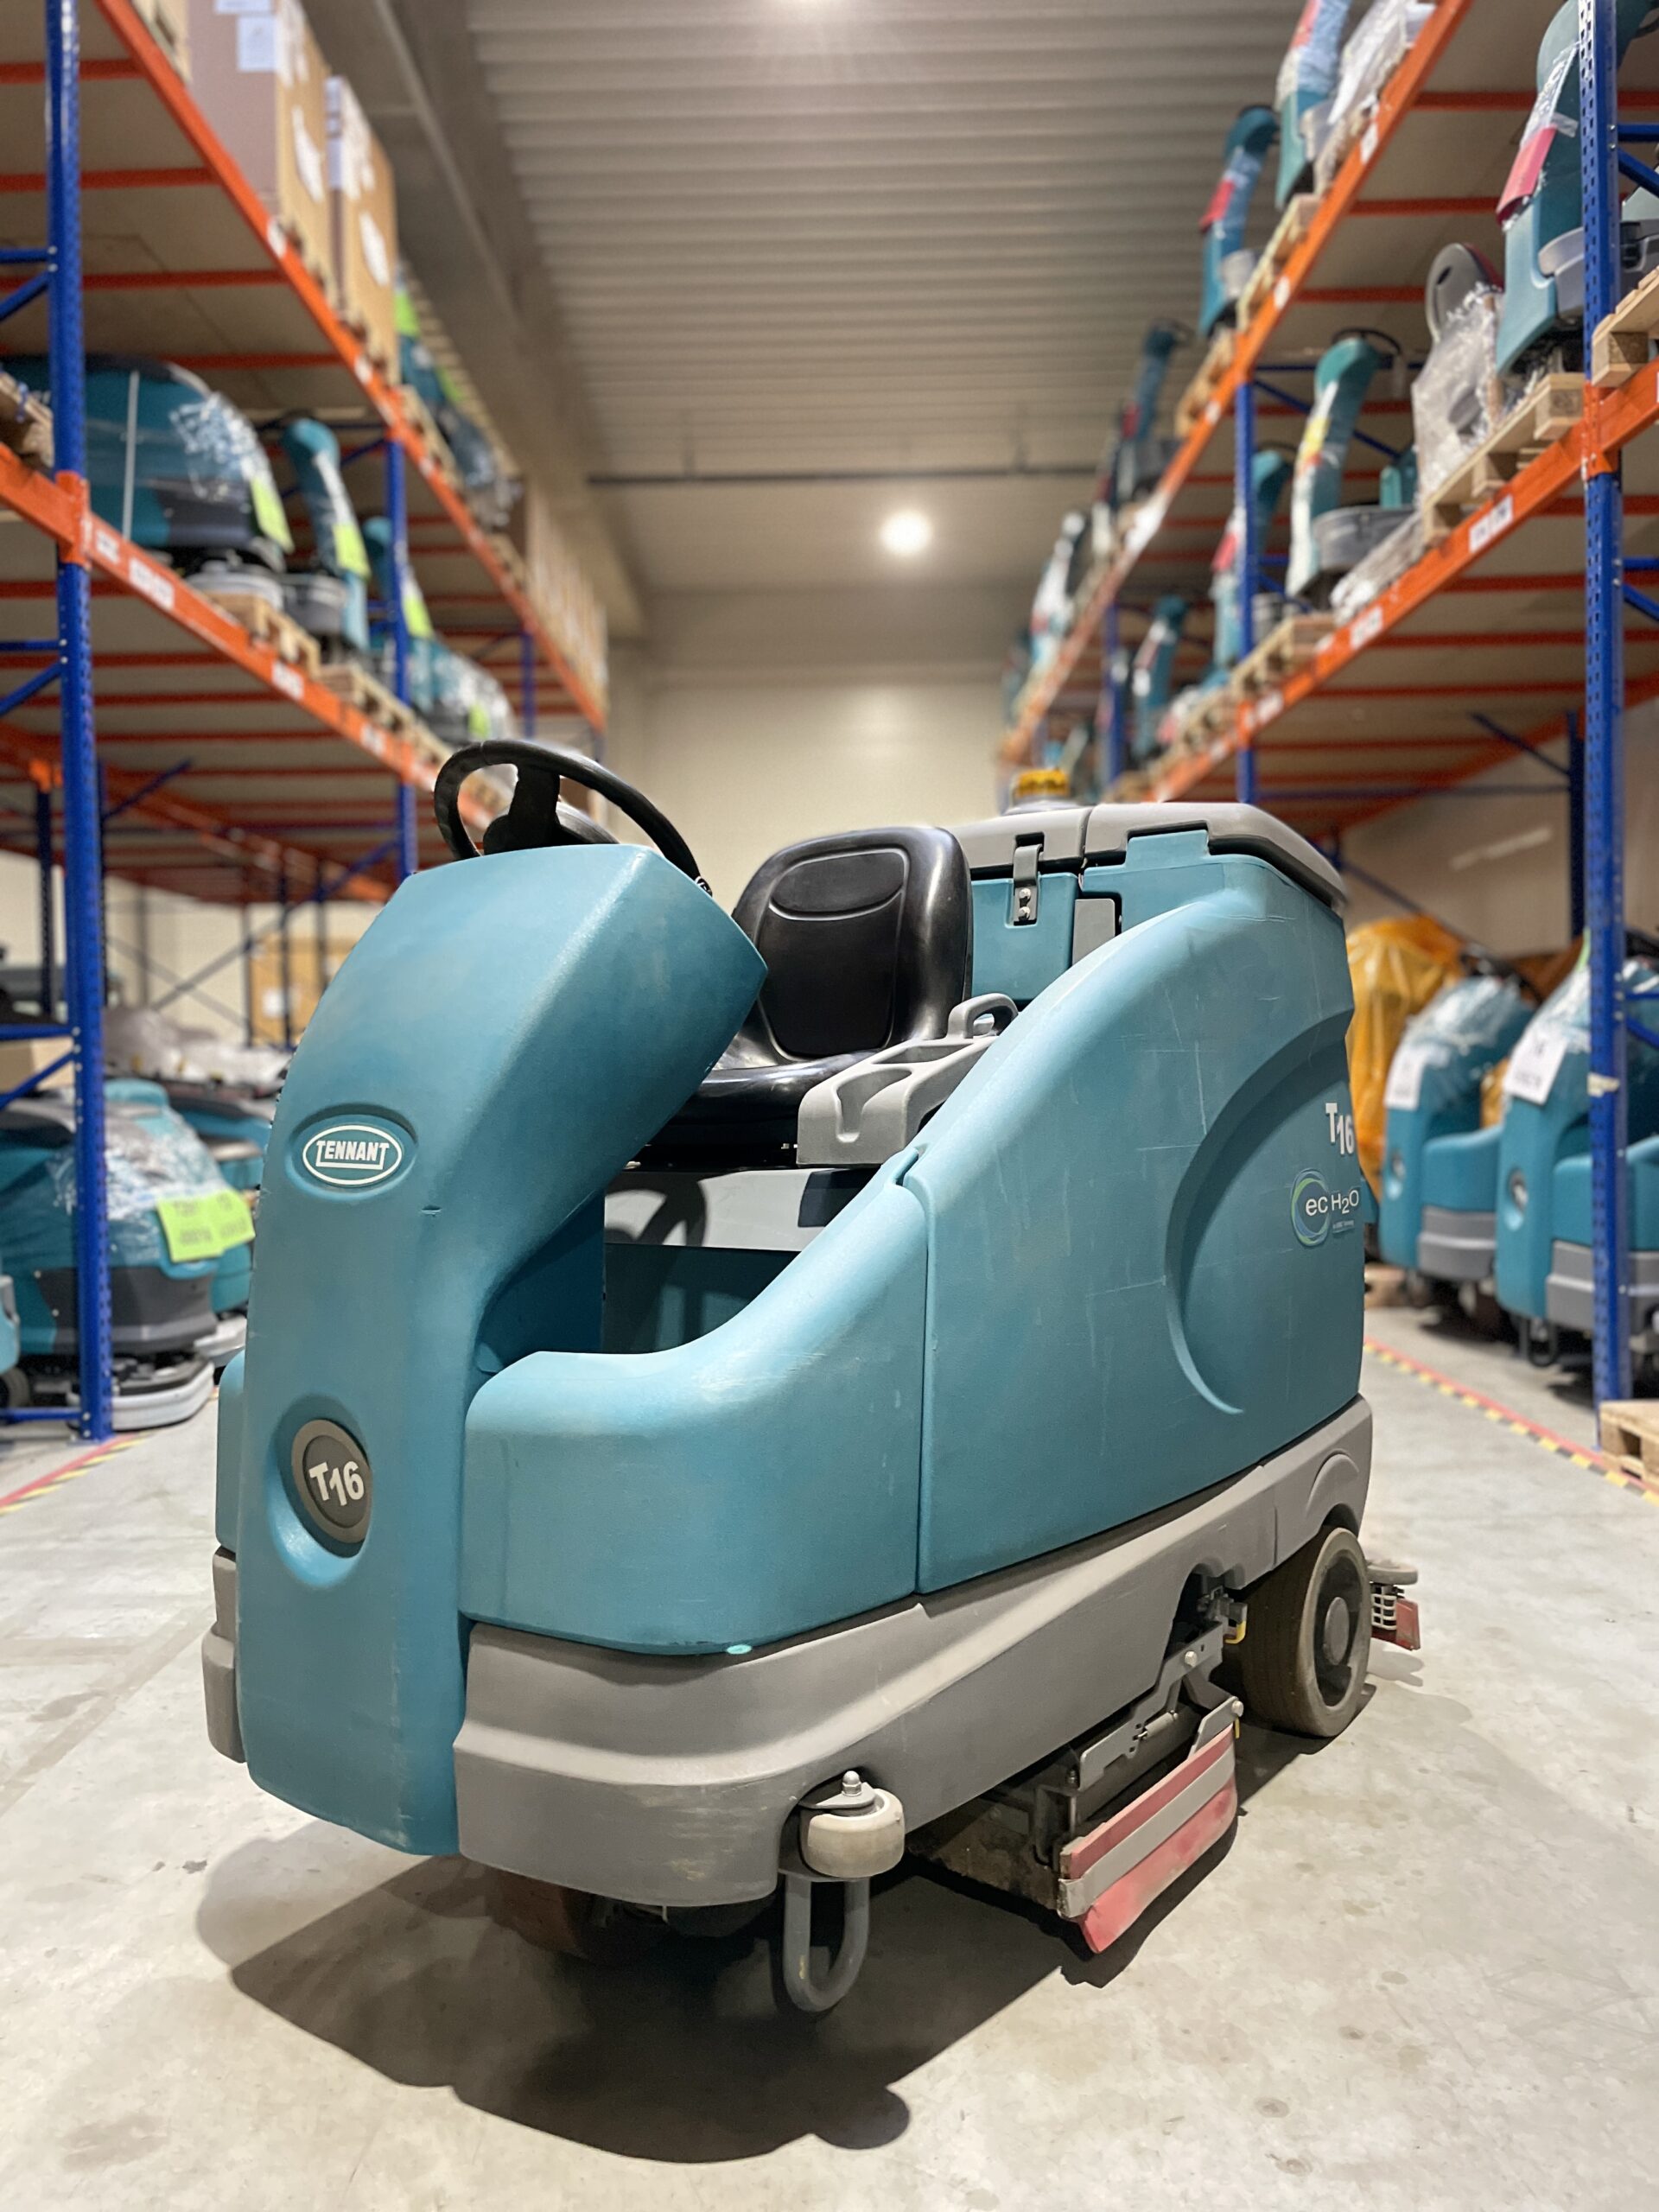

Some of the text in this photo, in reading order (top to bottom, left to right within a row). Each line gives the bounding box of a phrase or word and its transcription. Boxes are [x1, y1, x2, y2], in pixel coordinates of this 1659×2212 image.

[1325, 1103, 1355, 1155] T16
[316, 1140, 390, 1169] TENNANT
[308, 1461, 365, 1507] T16
